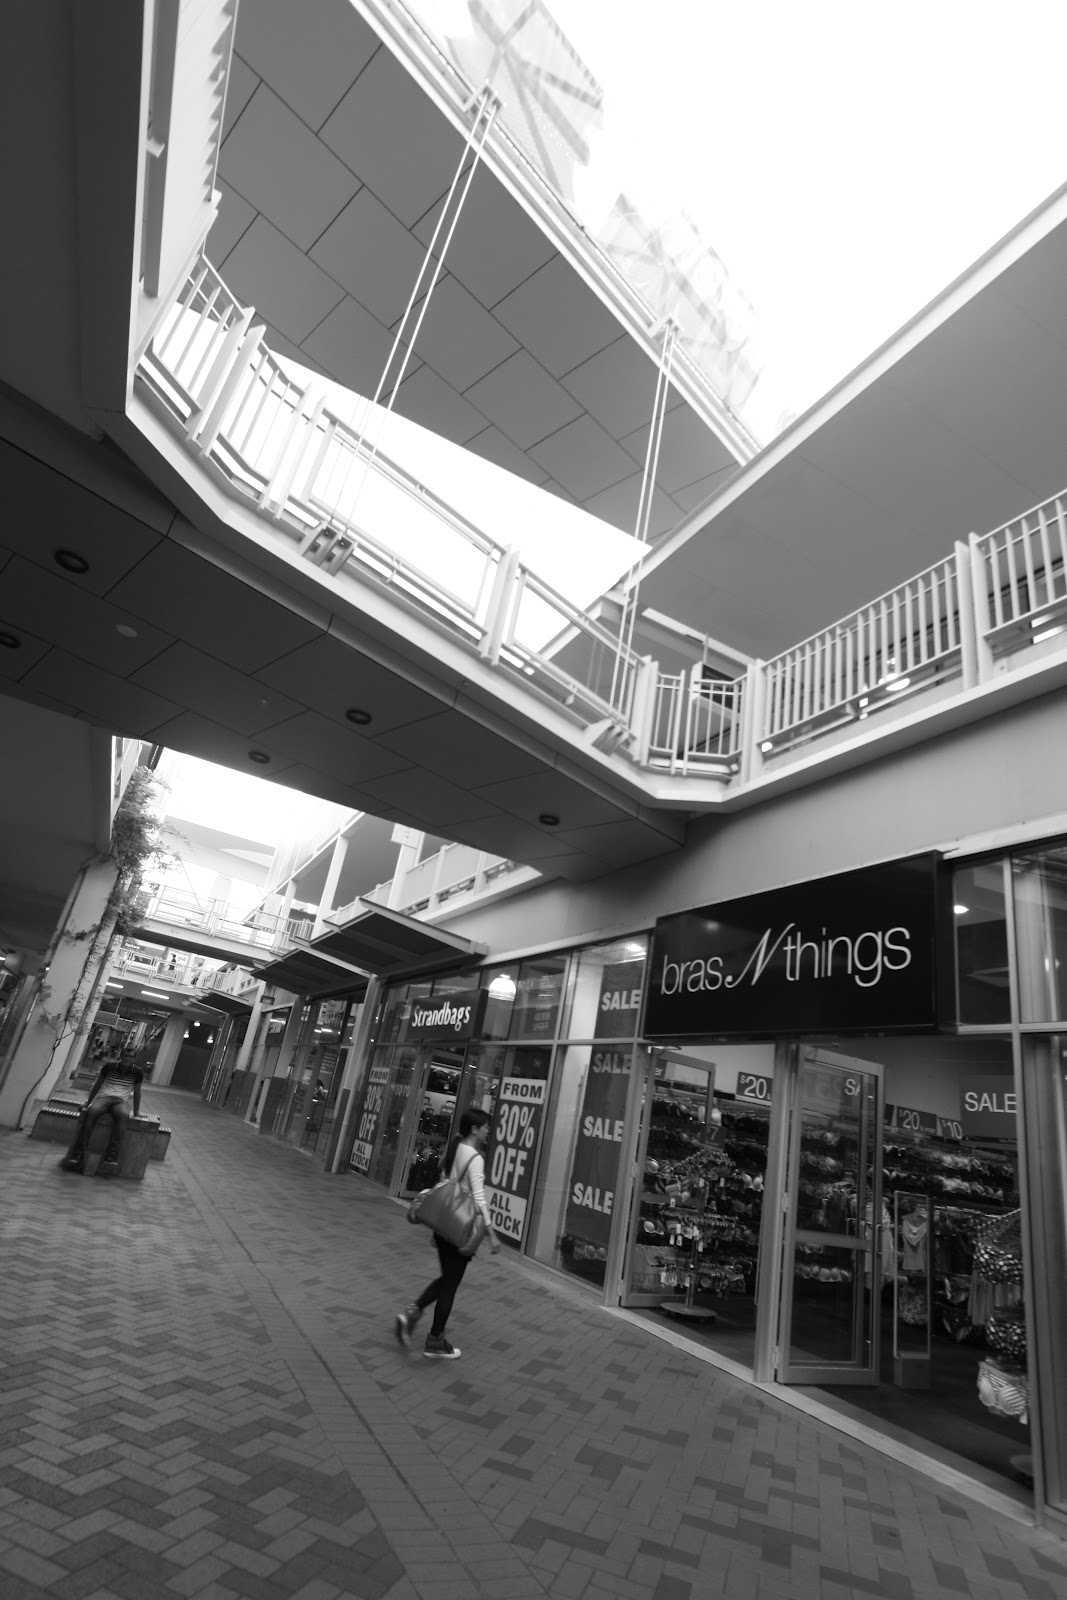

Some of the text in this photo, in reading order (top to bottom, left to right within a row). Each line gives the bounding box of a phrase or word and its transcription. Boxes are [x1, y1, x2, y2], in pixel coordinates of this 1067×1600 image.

[661, 955, 723, 995] bras
[783, 927, 912, 987] things
[601, 989, 641, 1011] SALE
[411, 1001, 472, 1032] Strandbags
[371, 1070, 388, 1081] FROM
[592, 1053, 632, 1074] SALE
[364, 1085, 384, 1113] 30%
[503, 1082, 542, 1099] FROM
[740, 1074, 767, 1099] $20
[965, 1092, 1017, 1113] SALE
[358, 1113, 377, 1141] OFF
[496, 1103, 536, 1149] 30%
[583, 1115, 624, 1143] SALE
[351, 1151, 369, 1168] STOCK
[355, 1142, 366, 1156] ALL
[491, 1144, 528, 1191] OFF
[490, 1192, 511, 1213] ALL
[572, 1182, 614, 1216] SALE
[489, 1208, 521, 1236] TOCK
